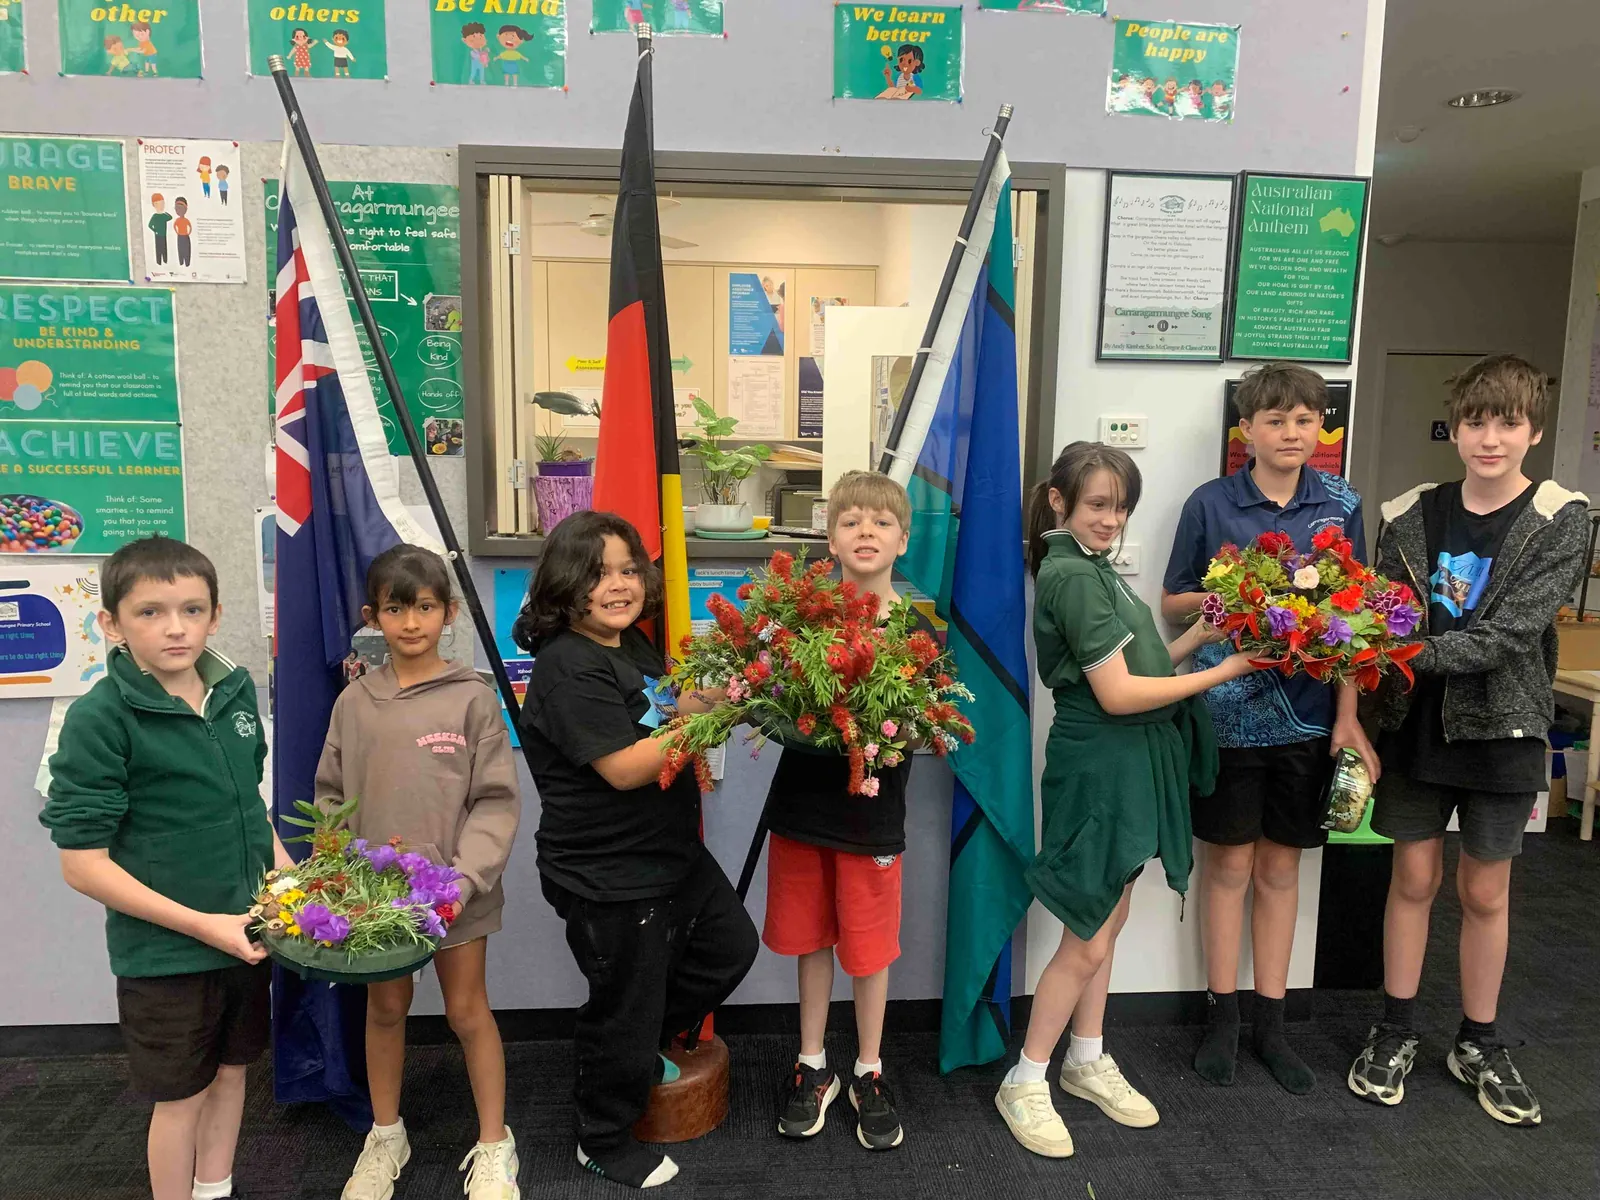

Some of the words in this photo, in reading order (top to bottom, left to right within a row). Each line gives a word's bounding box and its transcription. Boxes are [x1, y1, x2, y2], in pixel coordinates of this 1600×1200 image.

[269, 3, 360, 23] others
[435, 0, 475, 12] Be
[90, 3, 168, 24] other
[854, 7, 884, 22] We
[889, 7, 945, 24] learn
[866, 26, 931, 42] better
[1125, 23, 1191, 43] People
[1195, 31, 1228, 44] are
[1144, 42, 1207, 63] happy
[144, 145, 186, 155] PROTECT
[8, 175, 76, 192] BRAVE
[352, 184, 374, 201] At
[1251, 183, 1332, 200] Australian
[1250, 200, 1314, 217] National
[343, 226, 355, 235] he
[359, 227, 385, 240] right
[389, 228, 400, 236] to
[405, 227, 427, 237] feel
[431, 228, 456, 239] safe
[1248, 218, 1309, 234] Anthem
[349, 241, 410, 252] omfortable
[1114, 307, 1190, 319] Carraragarmungee
[1191, 309, 1212, 321] Song
[39, 326, 56, 337] BE
[62, 327, 99, 337] KIND
[104, 328, 114, 337] &
[13, 338, 141, 350] UNDERSTANDING
[427, 339, 451, 351] Being
[430, 353, 448, 361] Kind
[13, 464, 23, 474] A
[28, 464, 114, 475] SUCCESSFUL
[118, 465, 181, 476] LEARNER
[105, 495, 125, 503] Think
[146, 506, 174, 514] remind
[102, 529, 125, 537] going
[35, 652, 49, 661] right
[416, 732, 466, 747] WEEKEN
